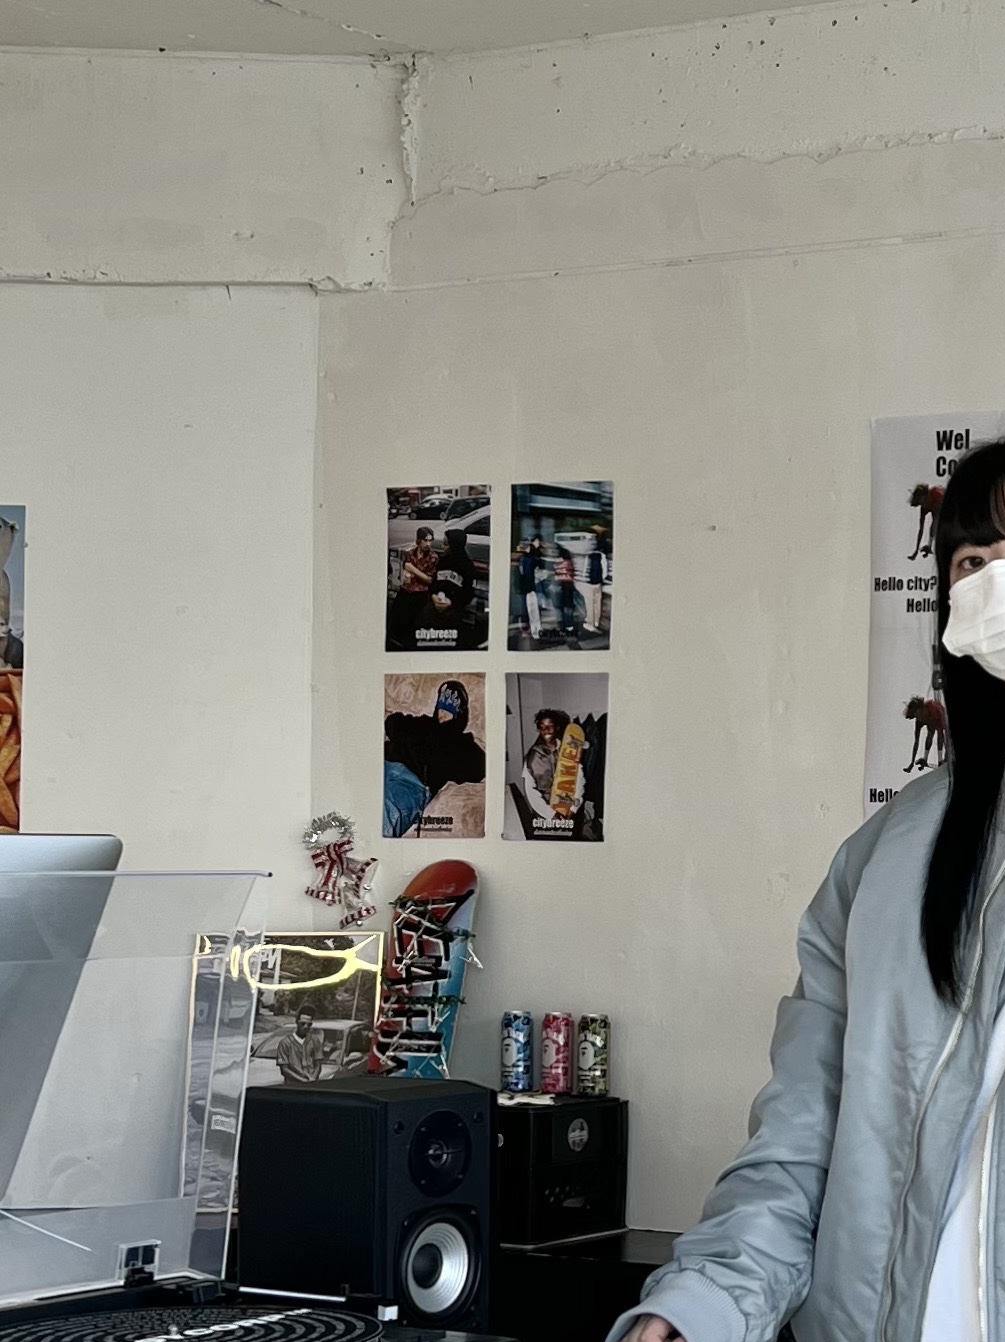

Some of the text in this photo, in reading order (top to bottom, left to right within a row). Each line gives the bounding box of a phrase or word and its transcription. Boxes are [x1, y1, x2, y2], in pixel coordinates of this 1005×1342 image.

[936, 429, 970, 451] Wel
[874, 576, 937, 592] Hello city?
[907, 598, 938, 612] Hello
